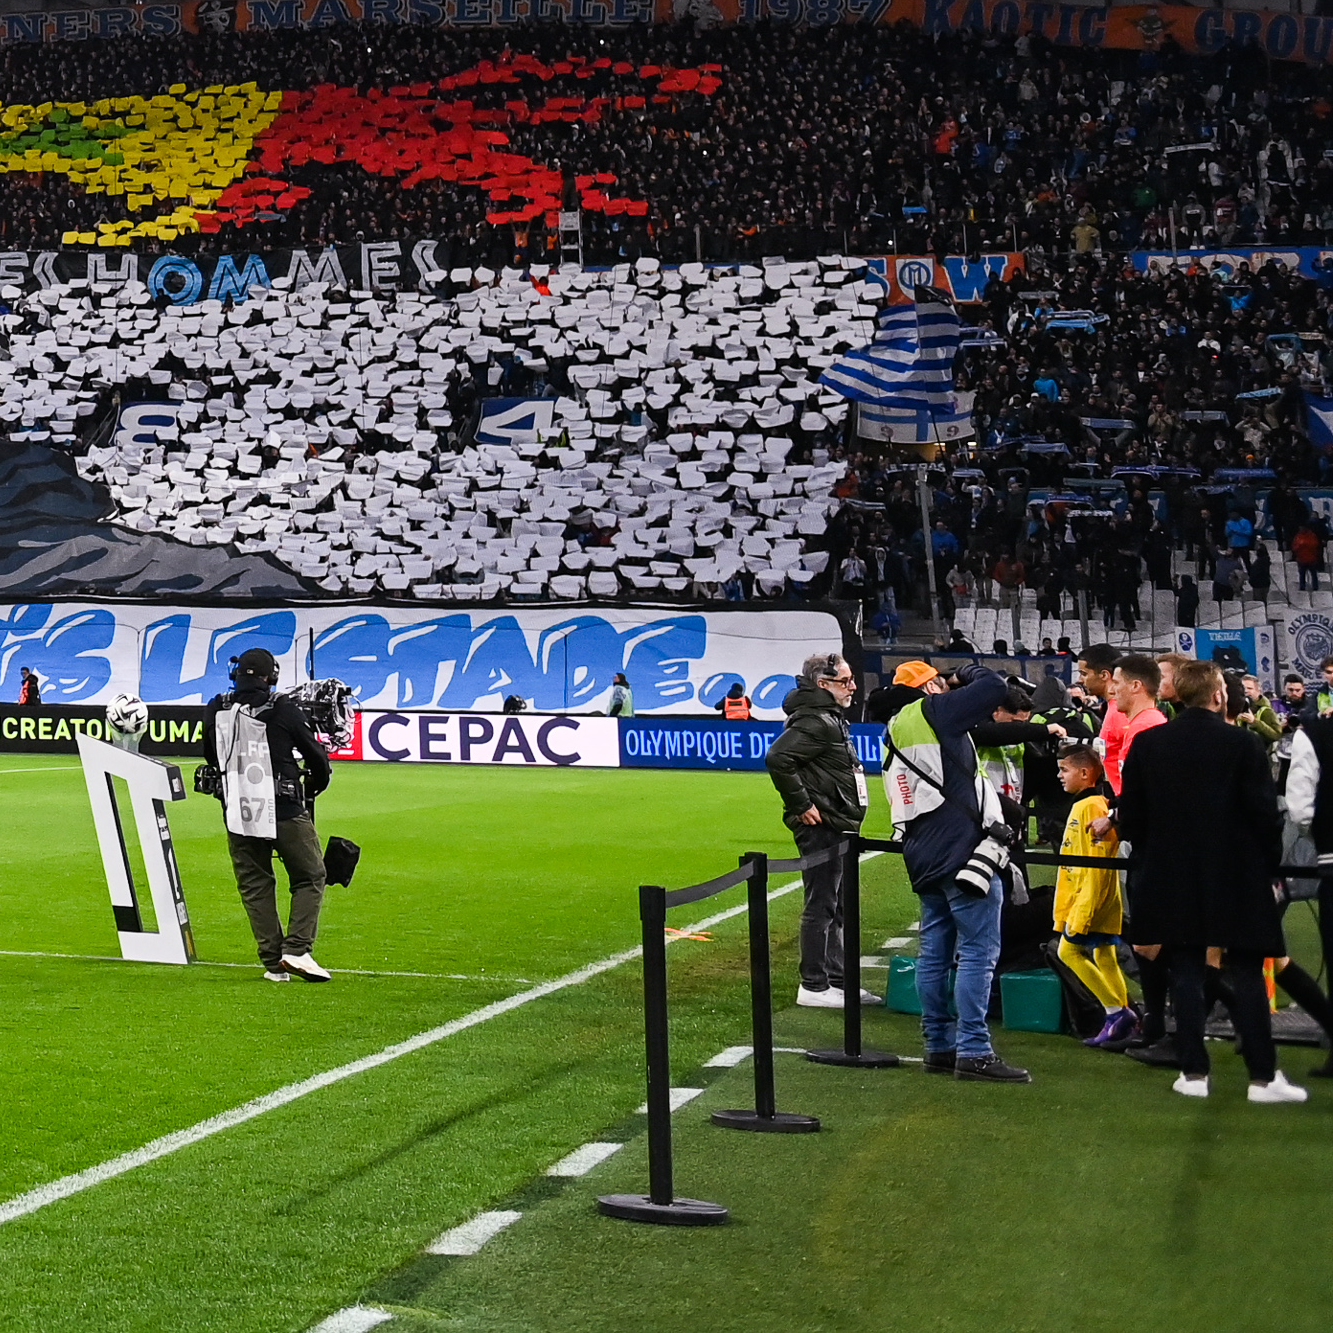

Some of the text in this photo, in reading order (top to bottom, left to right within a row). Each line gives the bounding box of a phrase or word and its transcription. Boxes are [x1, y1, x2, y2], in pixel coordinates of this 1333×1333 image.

[145, 719, 203, 743] UMA
[368, 713, 580, 764] CEPAC
[625, 729, 774, 760] OLYMPIQUE DE
[896, 773, 913, 806] PHOTO
[239, 796, 265, 822] 67
